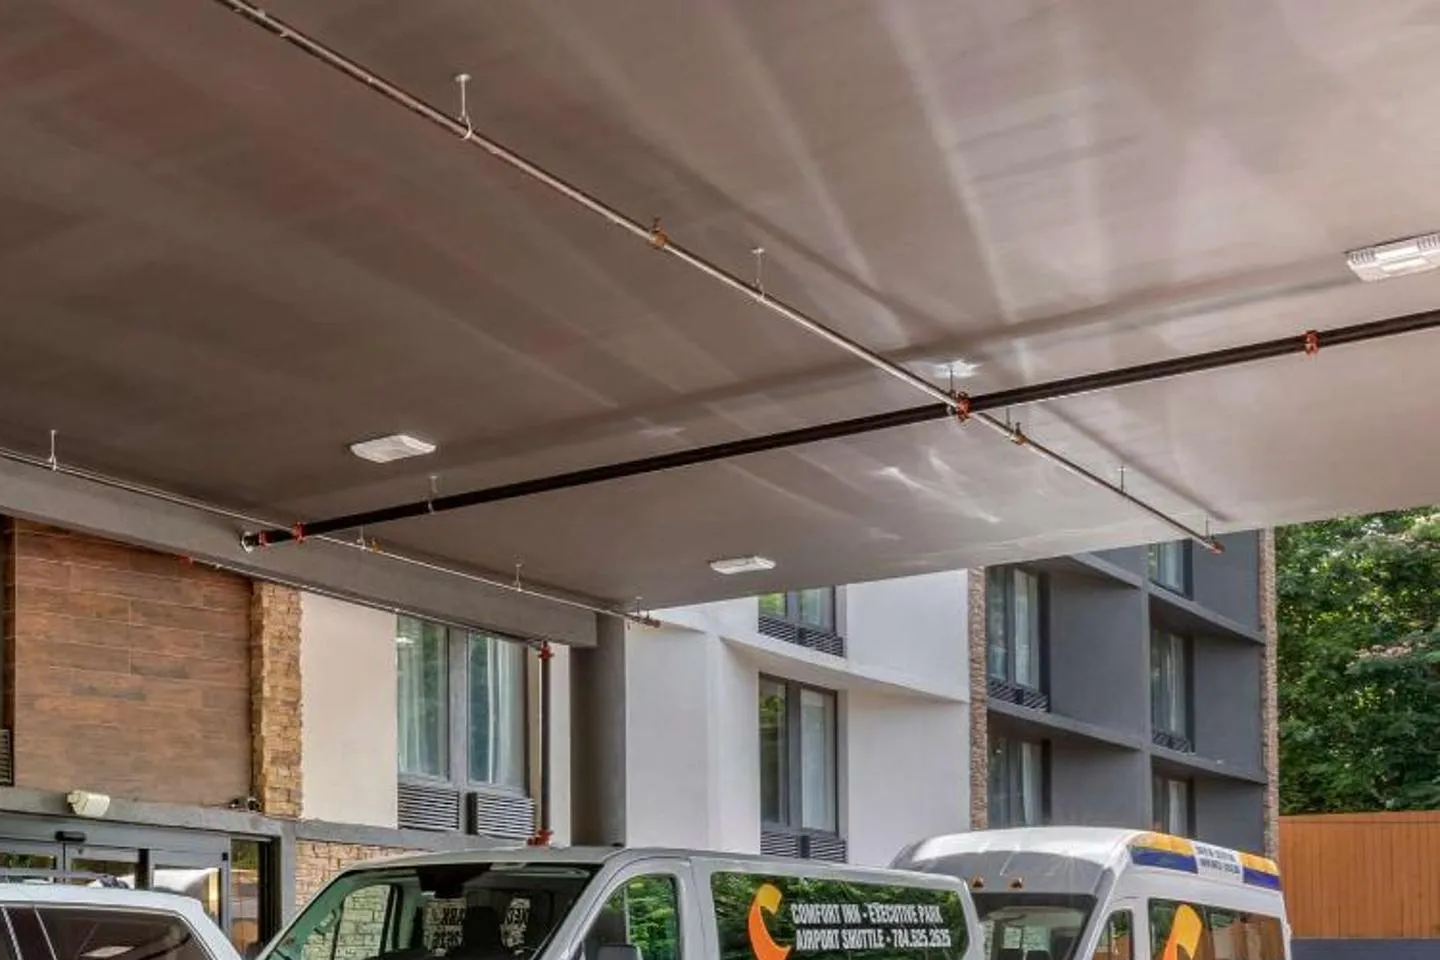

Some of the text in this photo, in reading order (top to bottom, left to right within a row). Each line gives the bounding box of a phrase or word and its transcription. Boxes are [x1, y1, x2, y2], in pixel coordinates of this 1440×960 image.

[791, 903, 841, 924] COMFORT
[841, 903, 862, 924] INN
[865, 902, 918, 924] EXECUTIVE
[918, 904, 943, 923] PARK
[796, 929, 840, 950] AIRPORT
[841, 929, 886, 949] SHUTTLE
